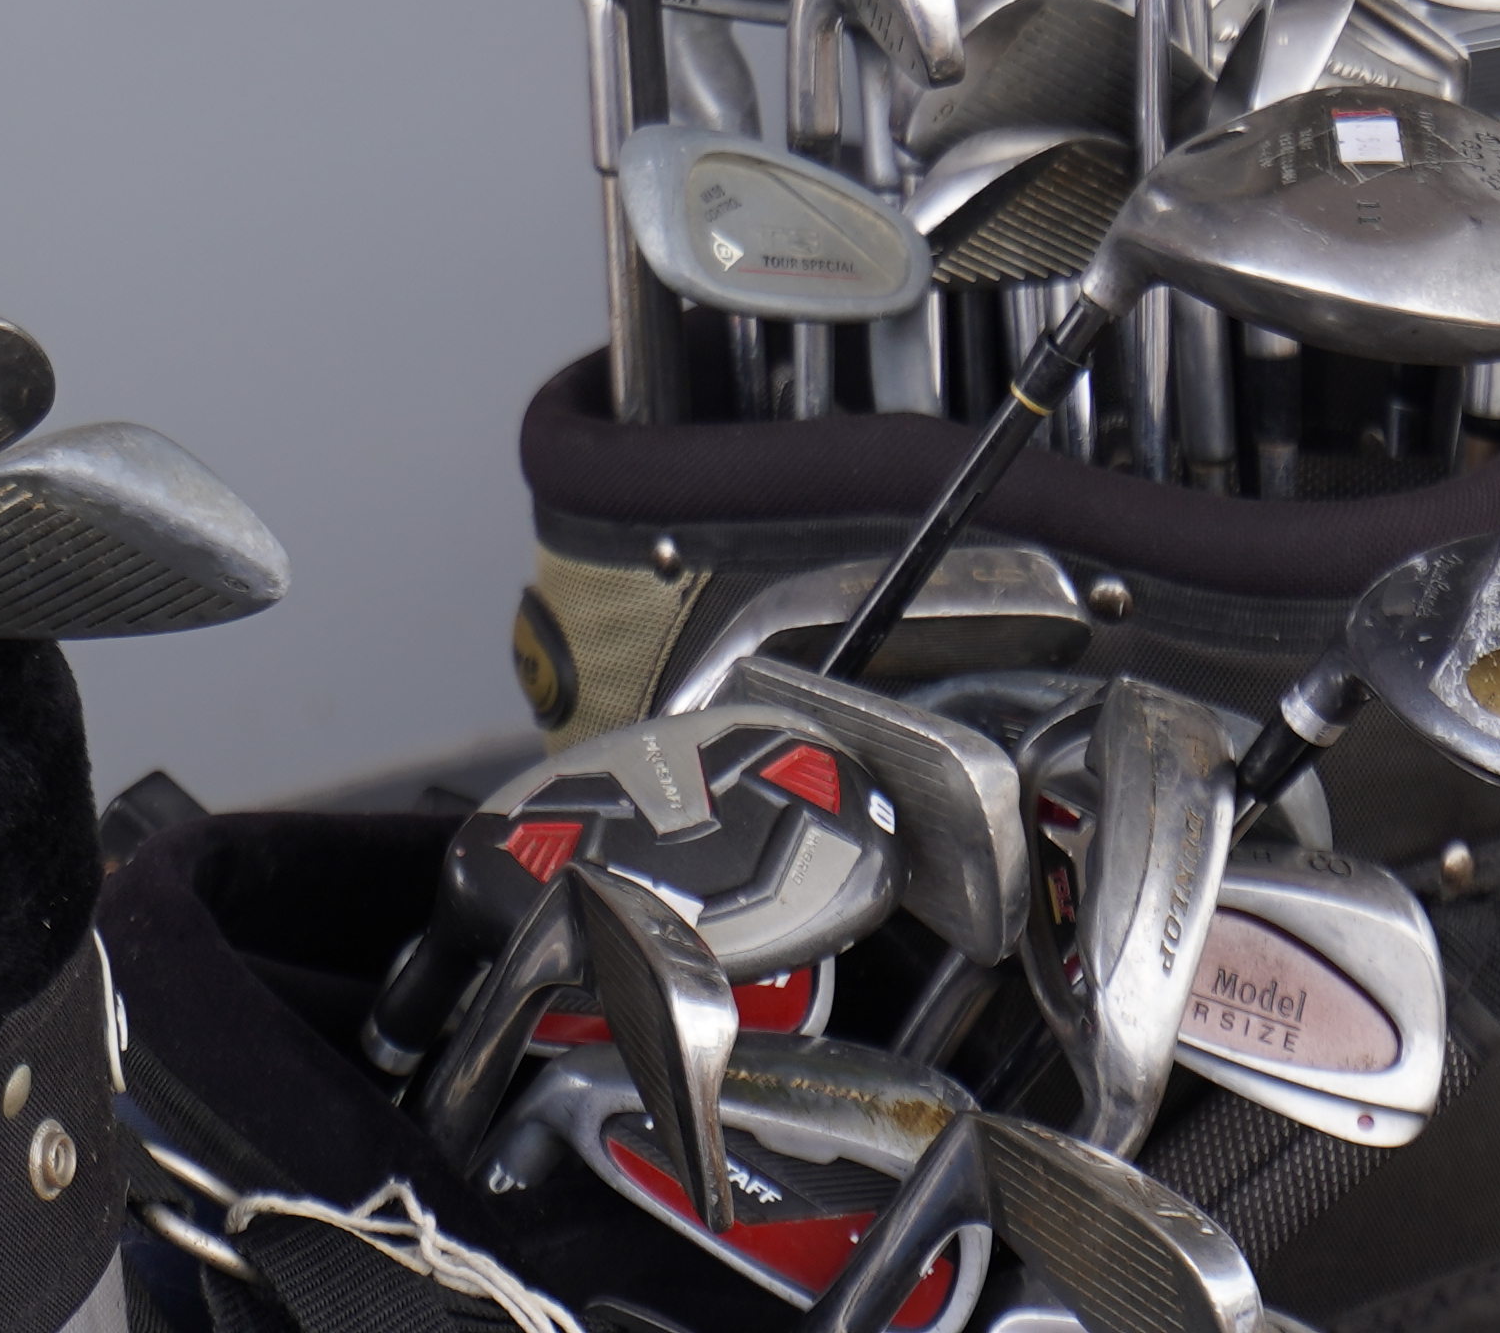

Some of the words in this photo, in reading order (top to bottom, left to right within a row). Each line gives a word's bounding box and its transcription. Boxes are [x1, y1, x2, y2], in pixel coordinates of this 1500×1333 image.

[762, 255, 800, 269] TOUR
[791, 830, 823, 886] HYBRID
[1159, 806, 1204, 978] DUNLOP
[1211, 968, 1308, 1023] Model
[725, 1160, 783, 1204] TAFF
